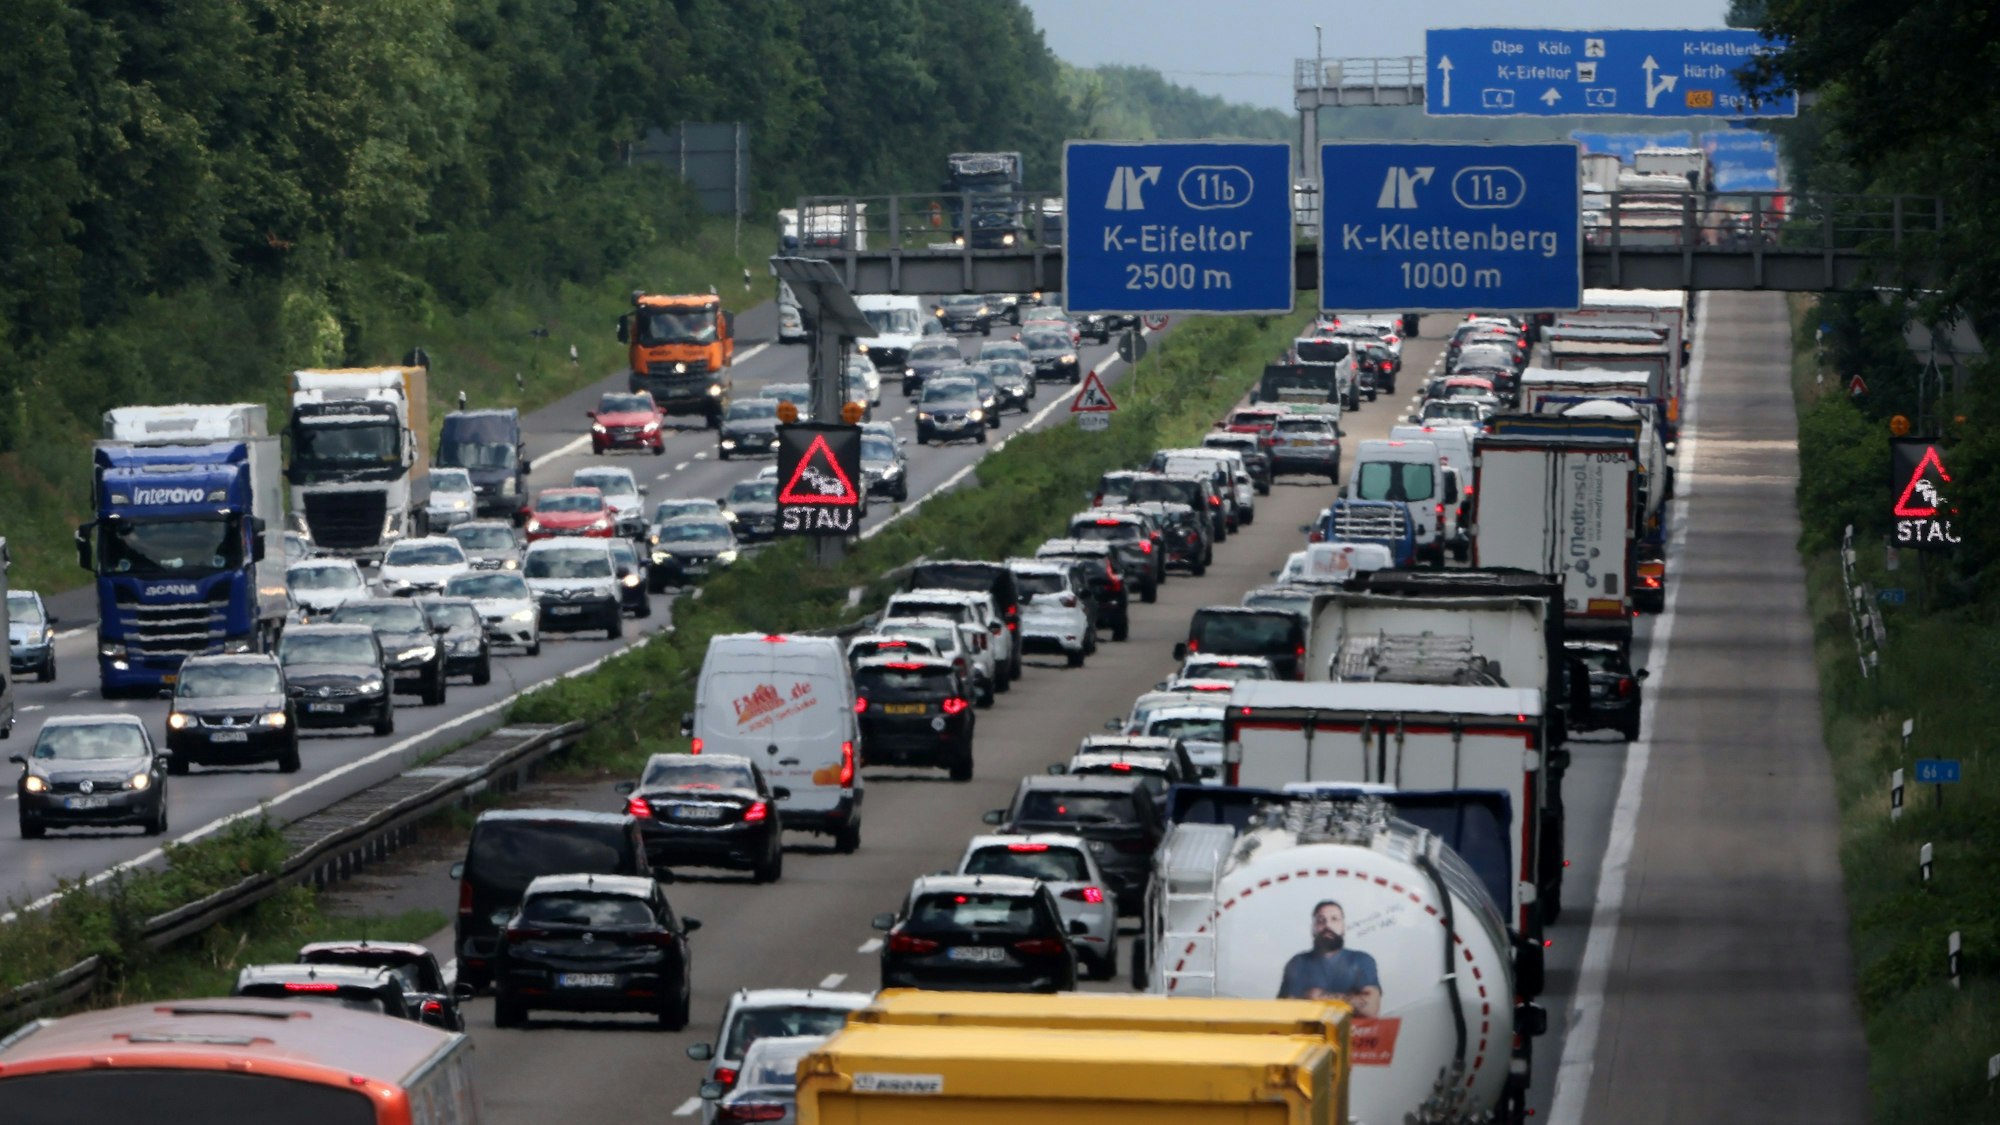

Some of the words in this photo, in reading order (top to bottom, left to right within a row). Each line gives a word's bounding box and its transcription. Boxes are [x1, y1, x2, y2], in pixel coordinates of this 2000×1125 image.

[1492, 40, 1524, 56] Olpe
[1538, 41, 1572, 55] Köln
[1683, 41, 1786, 56] K-Klettenb
[1497, 65, 1572, 80] K-Eifeltor
[1683, 63, 1726, 79] Hürth
[1196, 173, 1235, 202] 11b
[1471, 173, 1507, 202] 11a
[1103, 225, 1253, 253] K-Eifeltor
[1343, 223, 1558, 258] K-Klettenberg
[1126, 264, 1196, 291] 2500
[1203, 269, 1232, 290] m
[1401, 262, 1467, 289] 1000
[1474, 268, 1502, 289] m
[782, 505, 854, 531] STAU
[145, 584, 199, 597] SCANIA
